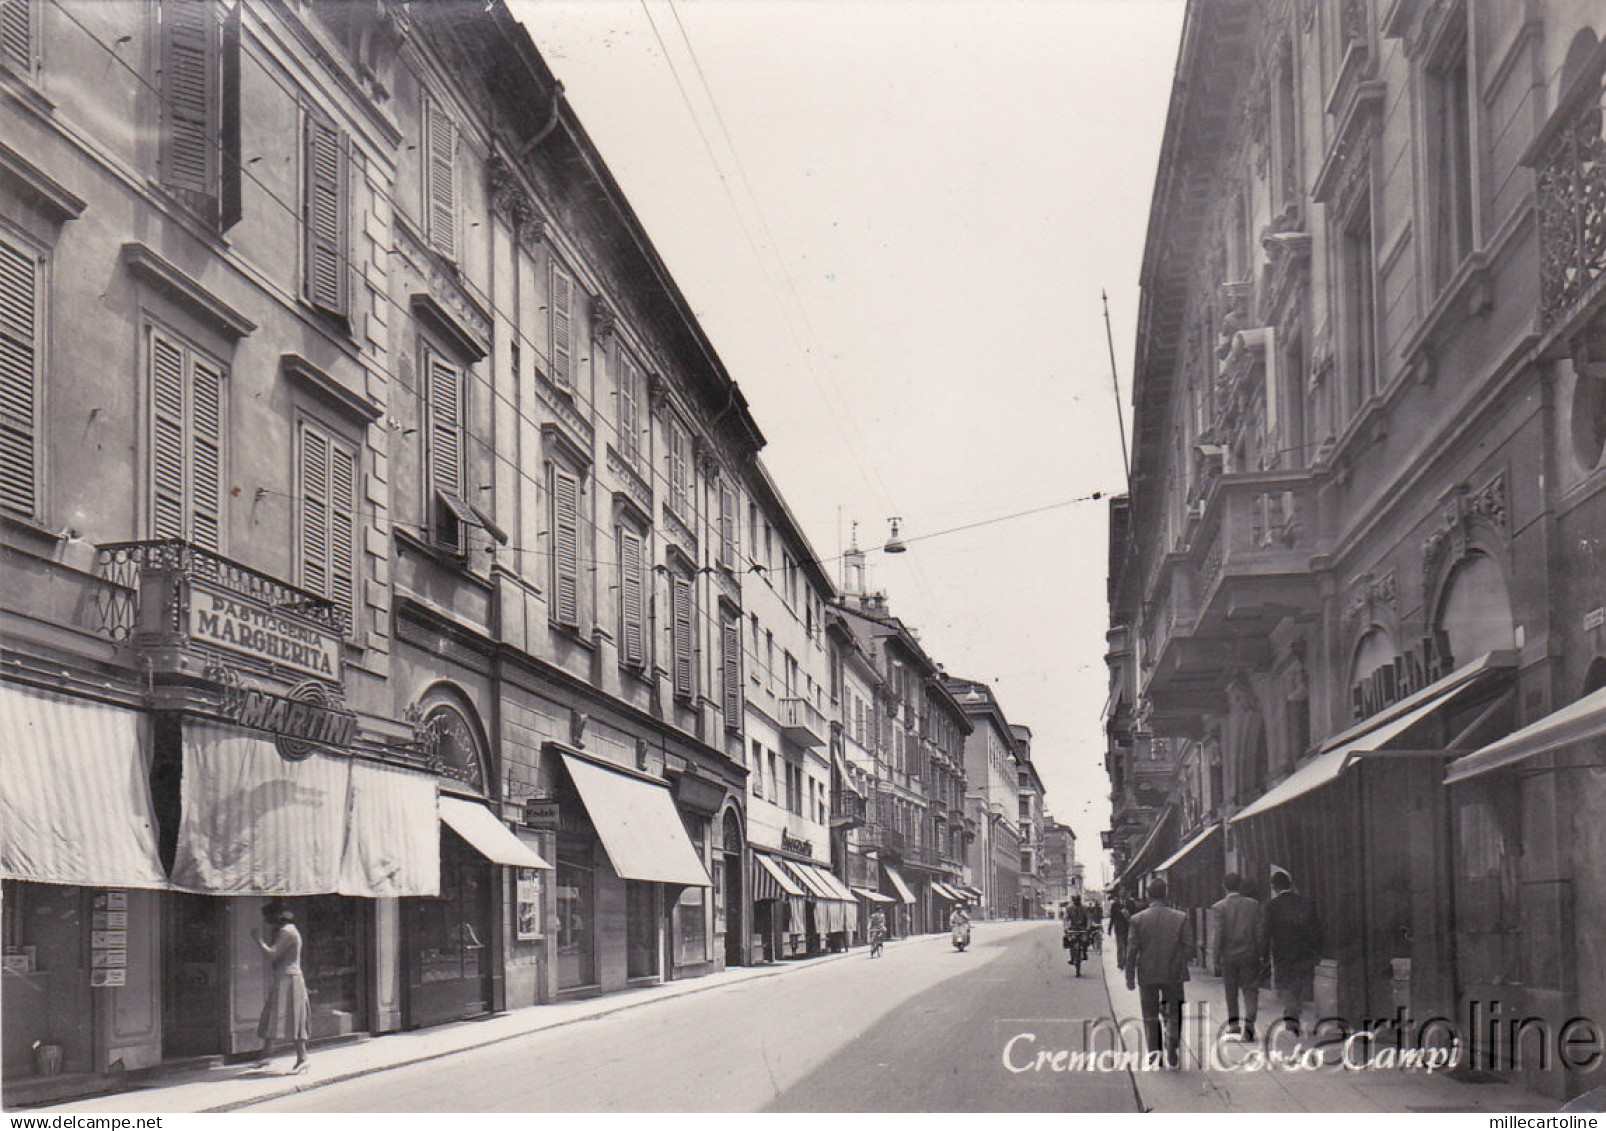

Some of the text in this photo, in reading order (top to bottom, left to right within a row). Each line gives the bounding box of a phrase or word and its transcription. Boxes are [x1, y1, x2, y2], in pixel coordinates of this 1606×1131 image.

[199, 610, 333, 676] MARGHERITA
[212, 595, 322, 649] PASTICCERIA
[239, 691, 357, 746] MARTINI
